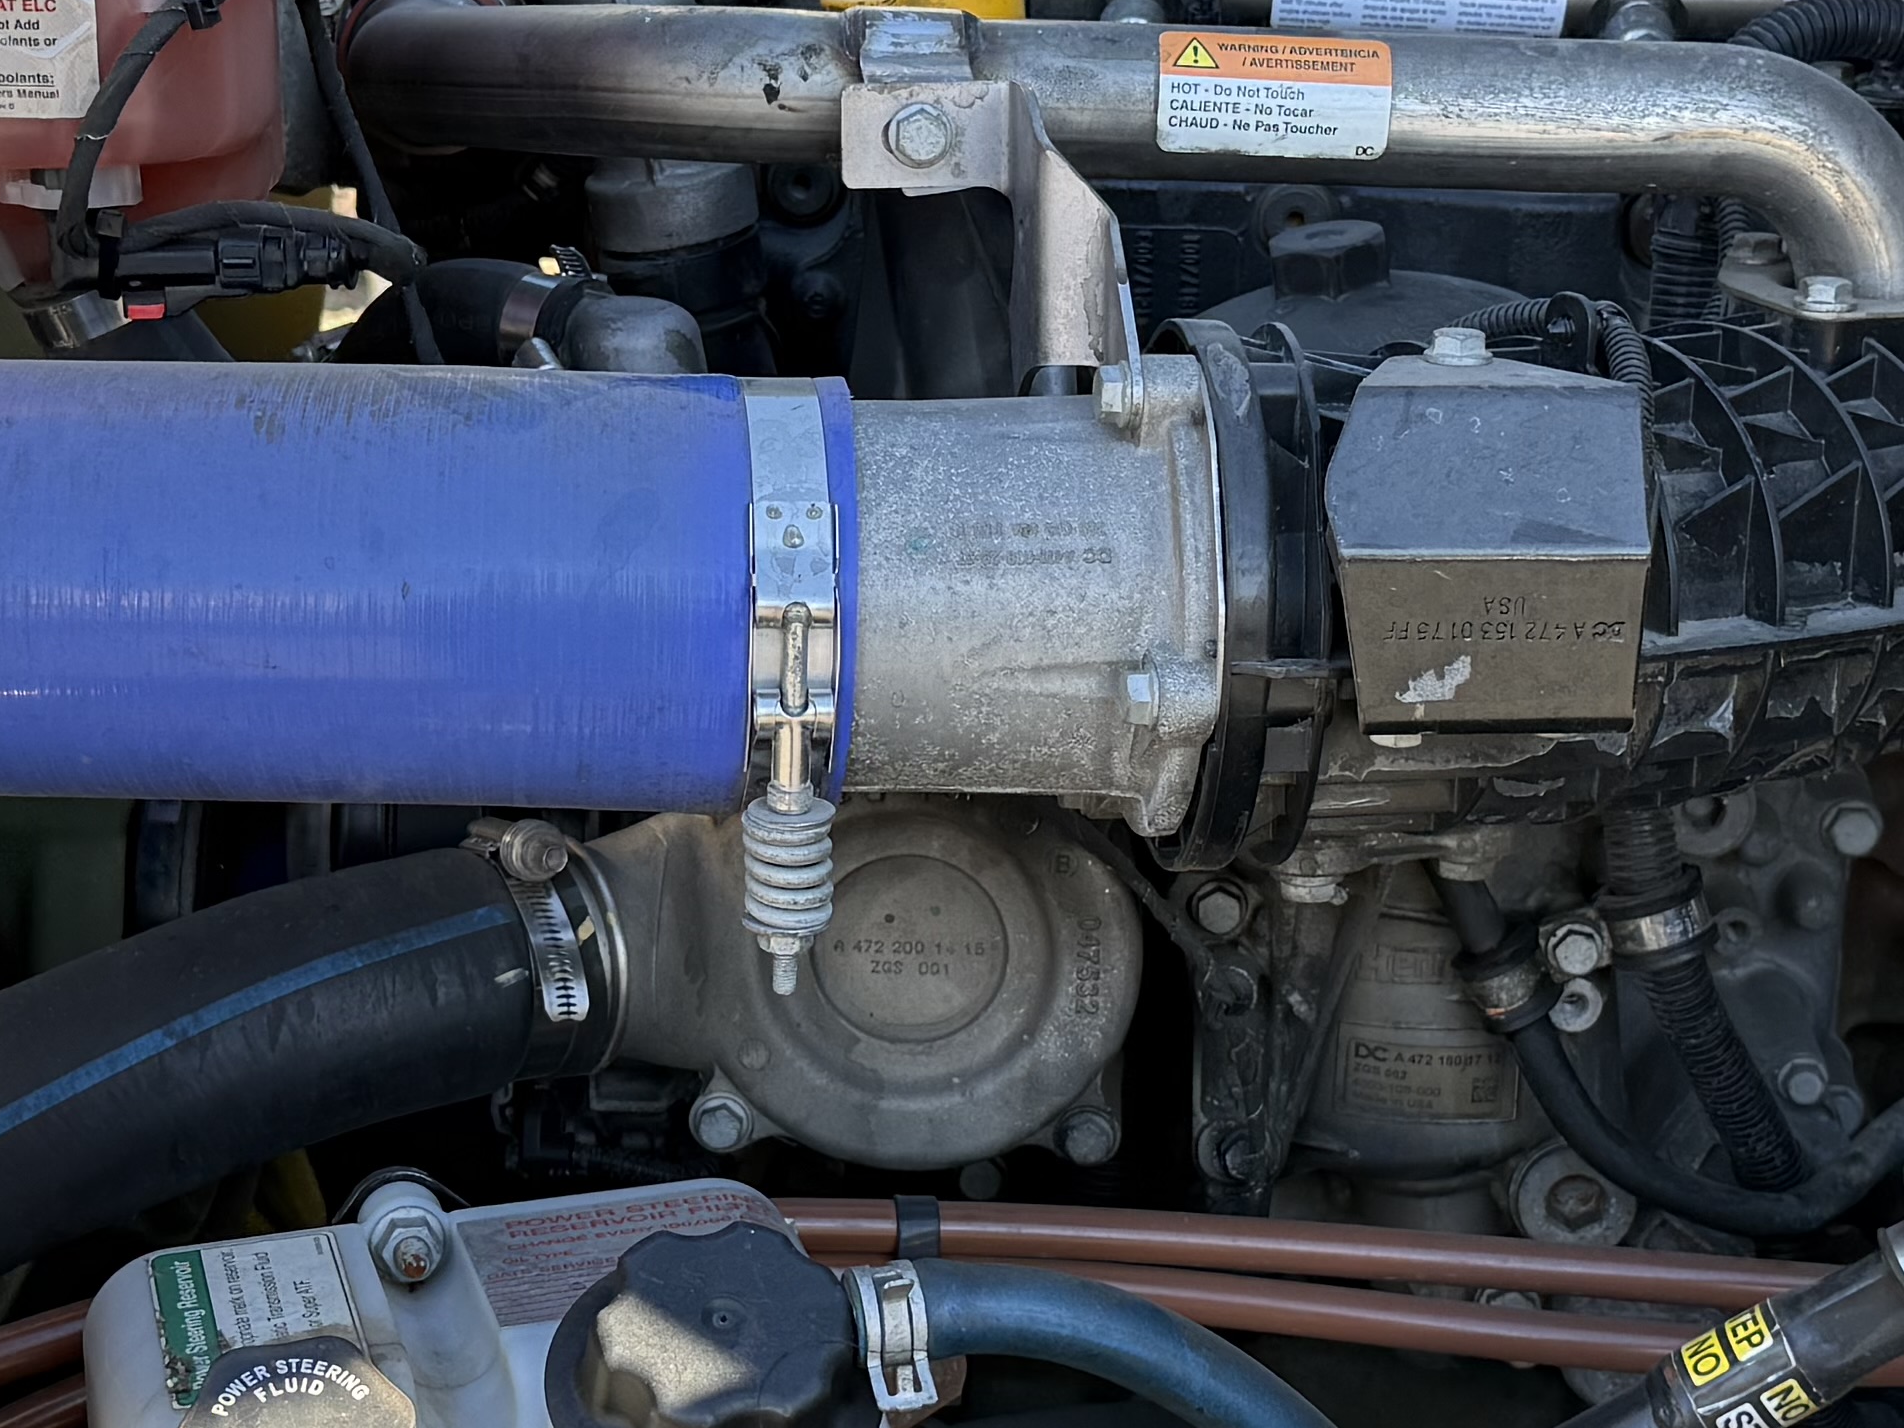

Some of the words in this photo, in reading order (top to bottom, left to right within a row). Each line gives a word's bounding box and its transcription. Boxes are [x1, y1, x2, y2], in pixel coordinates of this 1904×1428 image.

[22, 0, 57, 12] ELC
[14, 19, 39, 30] Add
[44, 37, 57, 46] or
[1217, 42, 1279, 54] WARNING
[1290, 46, 1380, 58] ADVERTENCIA
[1250, 58, 1356, 72] AVERTISSEMENT
[17, 88, 59, 98] Manual
[1171, 82, 1200, 94] HOT
[1214, 84, 1232, 97] Do
[1236, 86, 1260, 98] Not
[1263, 86, 1305, 100] Touch
[1170, 99, 1241, 114] CALIENTE
[1254, 104, 1273, 115] No
[1277, 104, 1314, 118] Tocar
[1168, 115, 1219, 129] CHAUD
[1232, 120, 1251, 131] Ne
[1255, 121, 1279, 133] Pas
[1283, 122, 1338, 135] Toucher
[1356, 146, 1374, 156] DC
[1484, 596, 1525, 616] USA
[504, 1208, 616, 1230] POWER
[509, 1210, 677, 1239] RESERVOIR
[506, 1234, 588, 1251] CHANGE
[595, 1226, 652, 1238] EVERY
[252, 1251, 271, 1271] Fluid
[534, 1250, 574, 1260] TYPE
[170, 1261, 197, 1308] Reservoir
[181, 1309, 209, 1354] Steering
[1685, 1335, 1720, 1376] NO
[211, 1365, 271, 1417] POWER
[275, 1358, 370, 1401] STEERING
[253, 1377, 324, 1403] FLUID
[1766, 1385, 1810, 1422] NO
